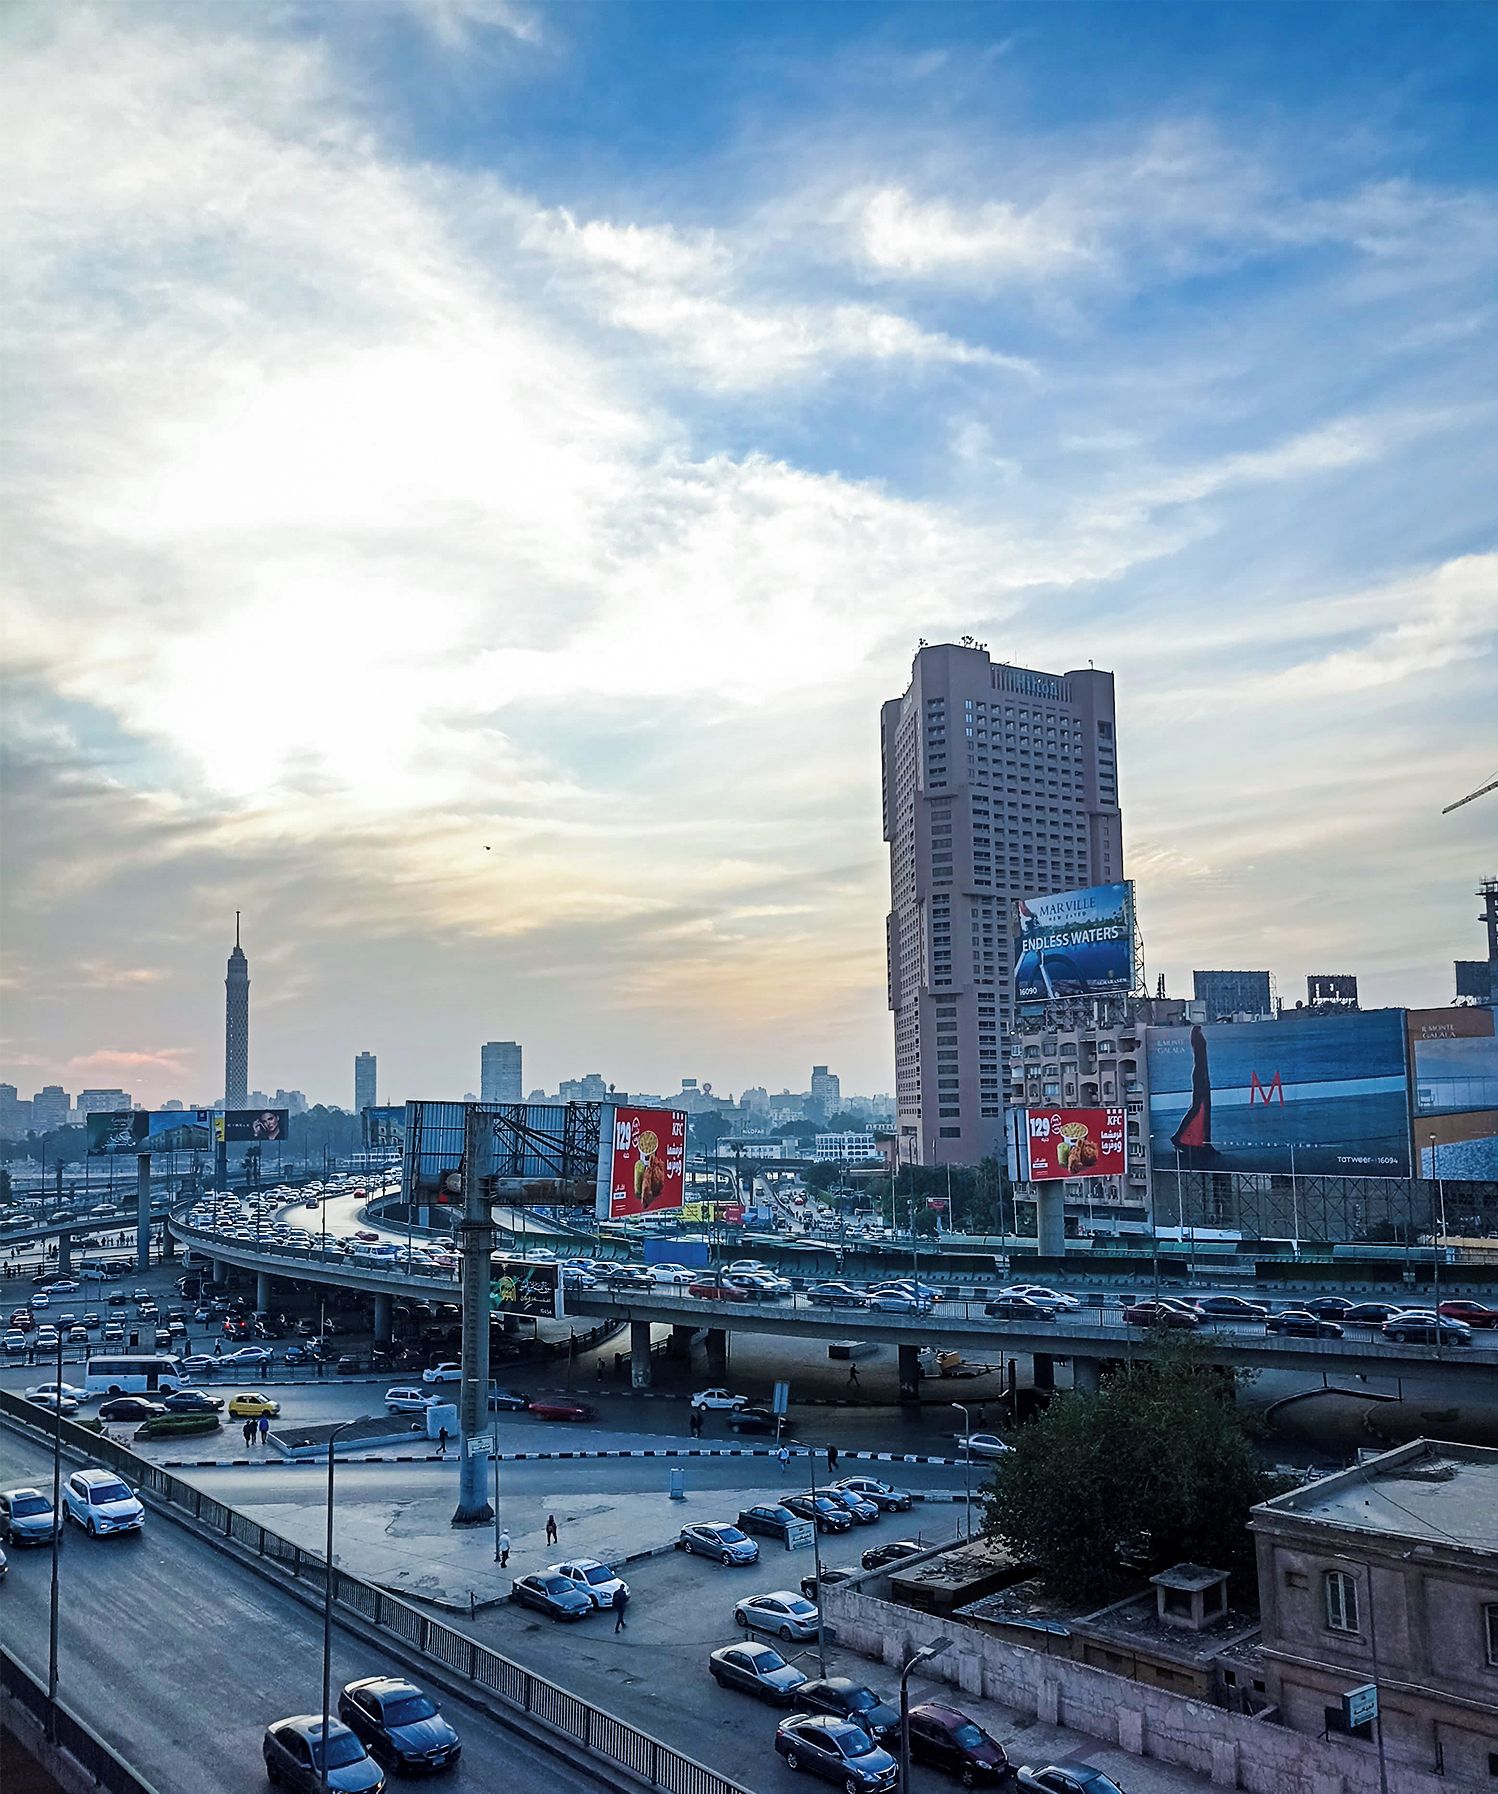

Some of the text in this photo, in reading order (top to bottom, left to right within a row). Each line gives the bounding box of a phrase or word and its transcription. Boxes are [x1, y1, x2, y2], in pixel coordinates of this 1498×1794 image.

[1040, 897, 1096, 916] MARVILLE
[1022, 925, 1119, 952] ENDLESS WATERS
[1019, 986, 1038, 996] 16090
[1250, 1071, 1284, 1109] M
[672, 1122, 684, 1136] KFC
[1030, 1117, 1050, 1137] 129
[1107, 1116, 1123, 1126] KFC
[616, 1121, 631, 1151] 129
[1377, 1156, 1398, 1164] 16094
